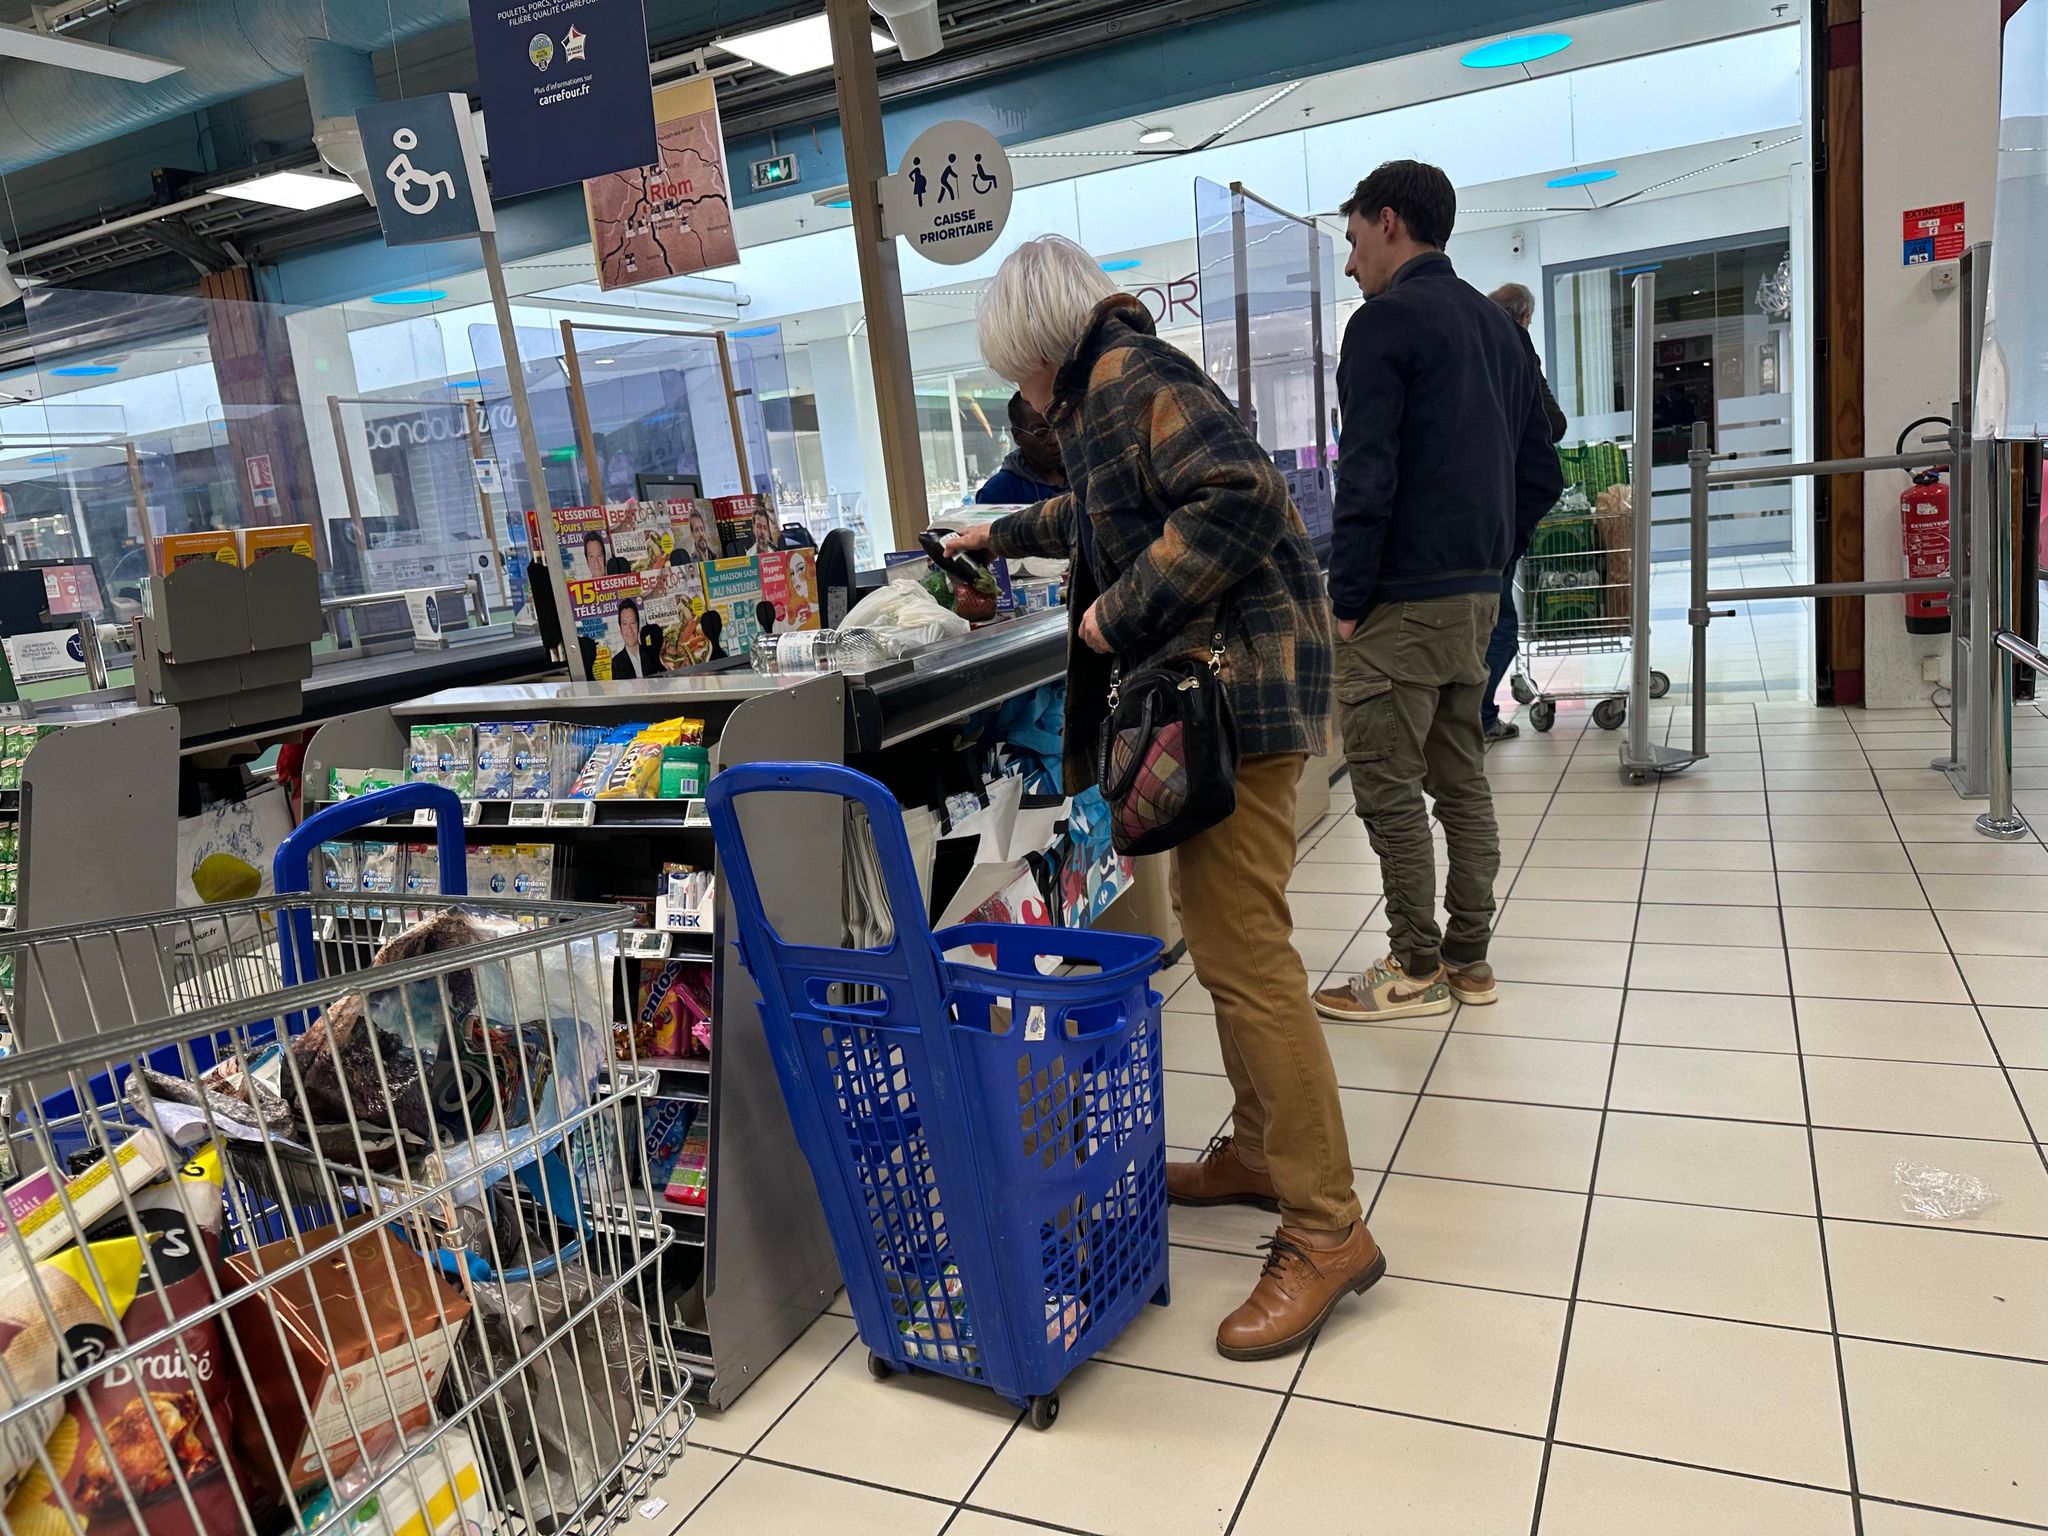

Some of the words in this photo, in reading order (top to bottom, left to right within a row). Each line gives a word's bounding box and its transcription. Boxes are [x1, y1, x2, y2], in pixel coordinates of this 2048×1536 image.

[497, 5, 528, 20] POULETS,
[509, 13, 532, 27] FILIÈRE
[532, 6, 560, 21] QUALITÉ
[560, 0, 599, 12] CARREFO
[533, 86, 545, 95] Plus
[545, 76, 584, 92] d'informations
[583, 74, 593, 82] sur
[539, 83, 591, 106] carrefour.fr
[650, 179, 693, 202] Riom
[933, 209, 976, 227] CAISSE
[1905, 203, 1963, 219] EXTINCTEUR
[919, 220, 993, 245] PRIORITAIRE
[560, 523, 581, 535] jours
[567, 533, 583, 544] JEUX
[569, 582, 596, 605] 15
[712, 586, 724, 597] AU
[725, 581, 758, 595] NATUREL
[596, 591, 617, 606] jours
[574, 605, 596, 618] TÉLÉ
[602, 602, 619, 613] JEUX
[411, 760, 438, 768] Freeden
[440, 757, 470, 767] Freedent
[479, 756, 510, 765] Freedent
[515, 756, 547, 765] Freedent
[325, 876, 353, 884] Freedent
[363, 875, 392, 883] Freedent
[408, 875, 437, 884] Freedent
[491, 879, 506, 888] Free
[515, 879, 547, 888] Freedent
[175, 927, 217, 950] arreour.fr
[641, 960, 681, 1022] entos
